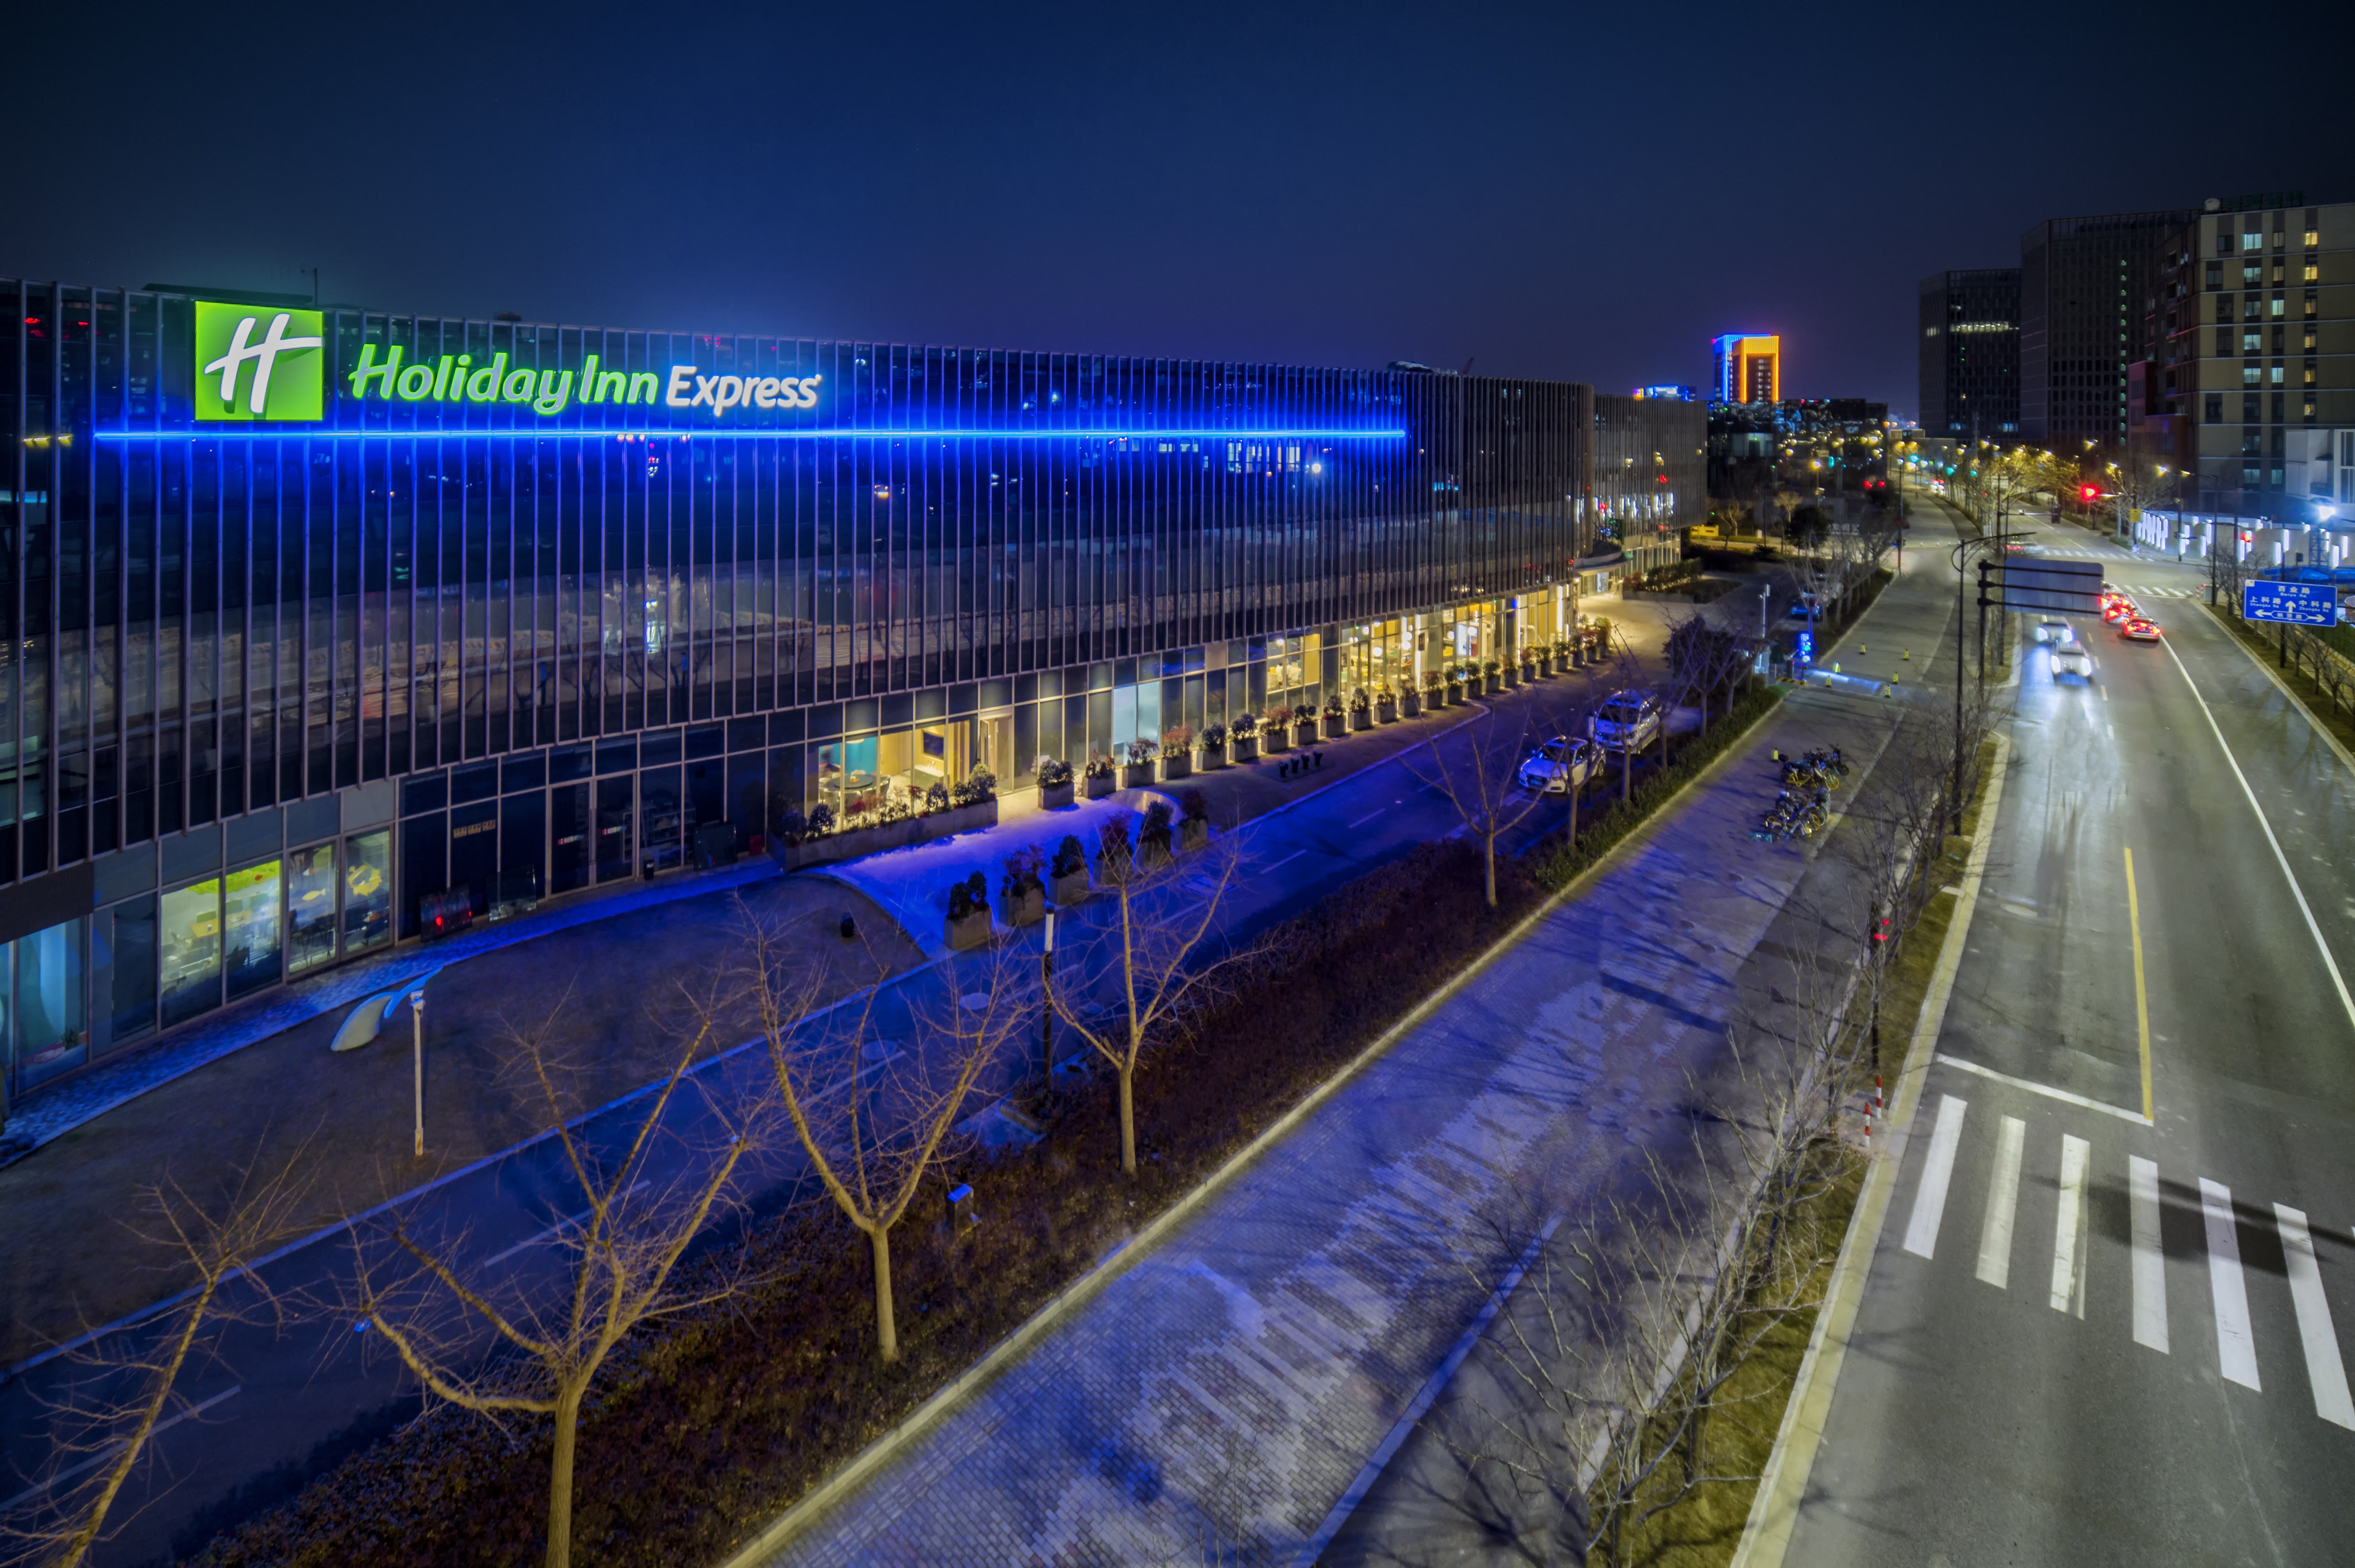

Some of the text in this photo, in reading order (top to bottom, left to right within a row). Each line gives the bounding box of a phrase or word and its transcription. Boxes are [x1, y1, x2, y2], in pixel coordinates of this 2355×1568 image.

[348, 344, 822, 416] Holiday Inn Express
[2278, 585, 2310, 594] 百业路
[2250, 596, 2281, 604] 上科路
[2299, 600, 2331, 609] 中科路
